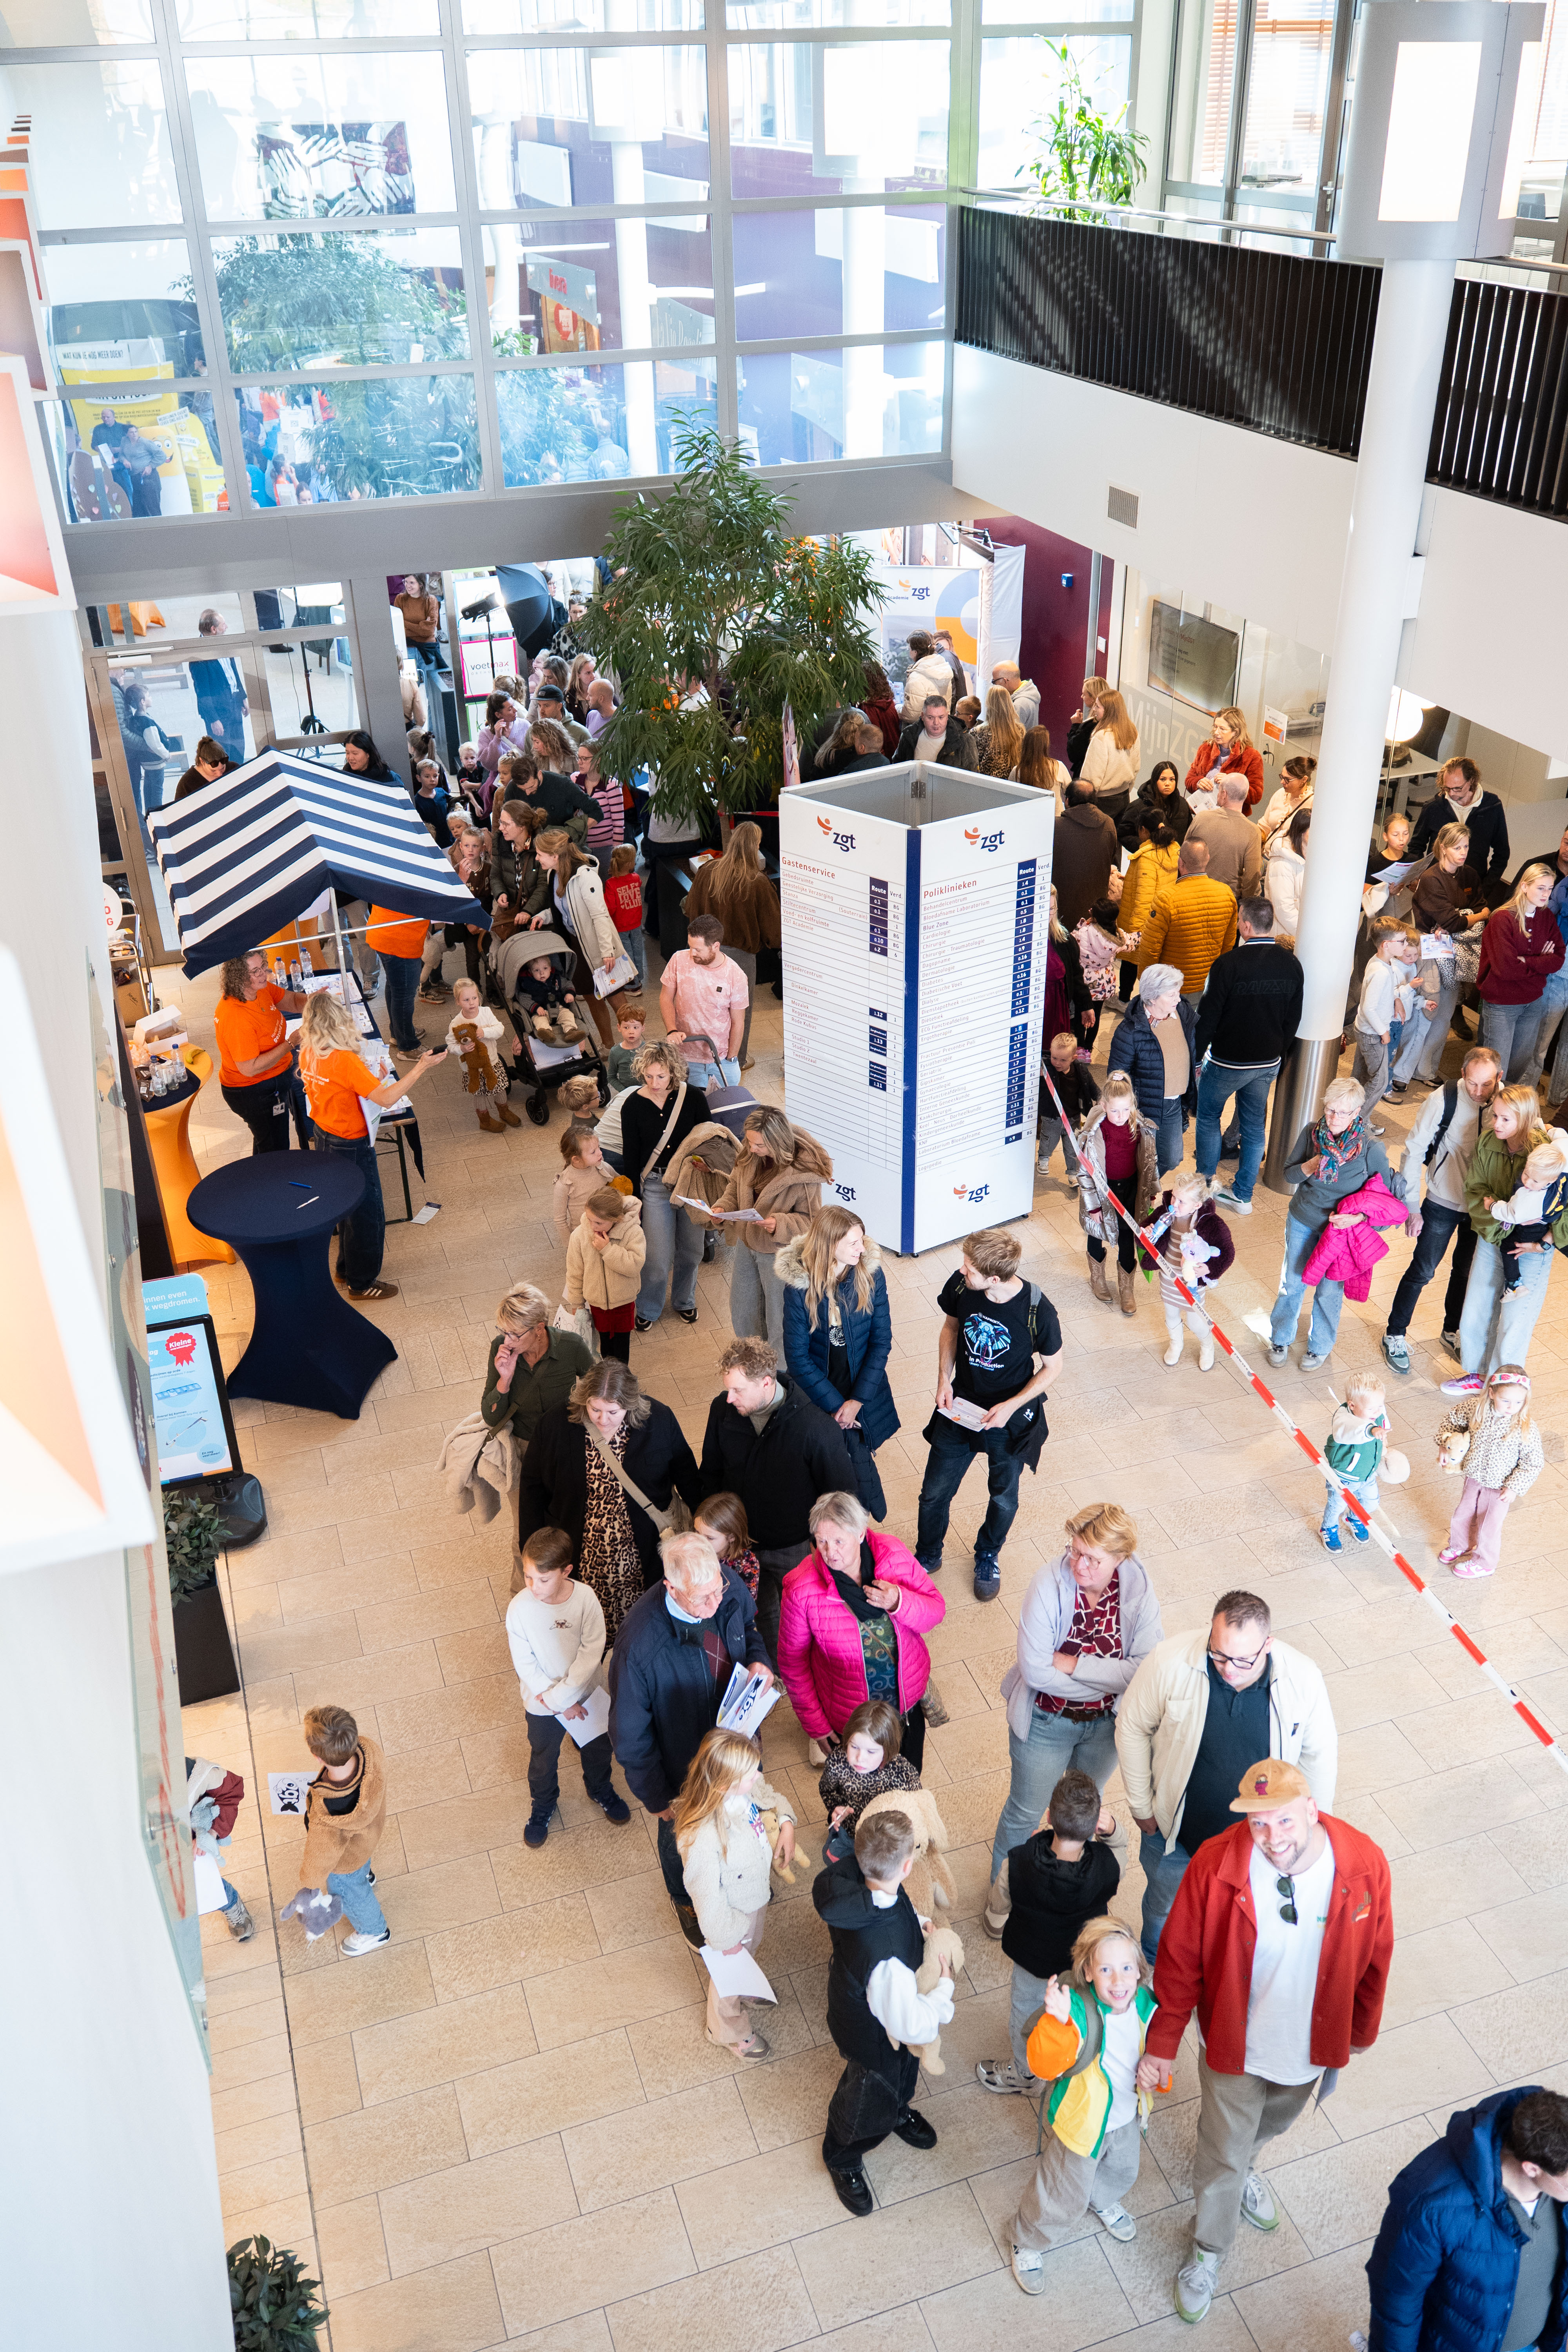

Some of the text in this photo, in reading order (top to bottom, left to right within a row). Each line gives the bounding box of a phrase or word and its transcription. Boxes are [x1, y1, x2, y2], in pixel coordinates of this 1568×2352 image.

[911, 586, 930, 600] zgt
[470, 661, 509, 670] voetmax
[1127, 689, 1202, 768] MijnZG
[833, 830, 856, 852] zgt
[980, 830, 1005, 852] zgt
[782, 871, 813, 884] Gebedsruimte
[782, 857, 902, 899] Gastenservice Route Verd.
[924, 862, 1051, 899] Poliklinieken Route Verd.
[617, 882, 635, 896] SELF
[618, 887, 641, 904] LOVE
[783, 881, 833, 901] Geestelijke Verzorging
[624, 898, 642, 909] CLUB
[783, 890, 867, 920] Stanza (Souterrain)
[783, 899, 816, 913] Stiltecentrum
[924, 897, 967, 911] Behandelcentrum
[924, 901, 989, 921] Bloedafname Laboratorium
[793, 920, 813, 931] Academie
[804, 915, 829, 927] kolfruimte
[923, 930, 951, 940] Cardiologie
[923, 940, 946, 949] Chirurgie
[923, 938, 985, 959] Chirurgie Traumatologie
[922, 958, 950, 968] Dagopname
[784, 962, 822, 980] Vergadercentrum
[922, 966, 955, 978] Dermatologie
[791, 982, 818, 995] Dinkelkamer
[922, 985, 950, 996] Diabetische
[791, 1000, 809, 1009] Mozaïek
[922, 1000, 959, 1014] Dienstapotheek
[792, 1009, 818, 1021] Reggekamer
[803, 1021, 816, 1029] Kubus
[932, 1016, 969, 1029] Functieafdeling
[791, 1033, 806, 1043] Studio
[921, 1030, 952, 1042] Ergotherapie
[792, 1042, 806, 1052] Studio
[921, 1051, 940, 1059] Fractuur
[943, 1044, 965, 1053] Preventie
[793, 1051, 816, 1064] Twentezaal
[920, 1056, 952, 1069] Fysiotherapie
[920, 1068, 942, 1077] Geriatrie
[920, 1076, 944, 1086] Gipskamer
[920, 1083, 950, 1095] Gynaecologie
[920, 1087, 966, 1103] Hartfunctieafdeling
[920, 1104, 938, 1112] Interne
[939, 1094, 970, 1106] Geneeskunde
[920, 1108, 951, 1121] Kaakchirurgie
[950, 1105, 982, 1120] Oorheelkunde
[919, 1120, 964, 1137] Kindergeneeskunde
[919, 1132, 980, 1154] Laboratorium Bloedafname
[918, 1161, 942, 1171] Logopedie
[835, 1183, 856, 1202] zgt
[968, 1183, 990, 1203] zgt
[152, 1297, 200, 1310] wegdromen.
[983, 1315, 1000, 1324] HAPROXY
[169, 1338, 192, 1348] Kleine
[975, 1358, 1004, 1368] Production
